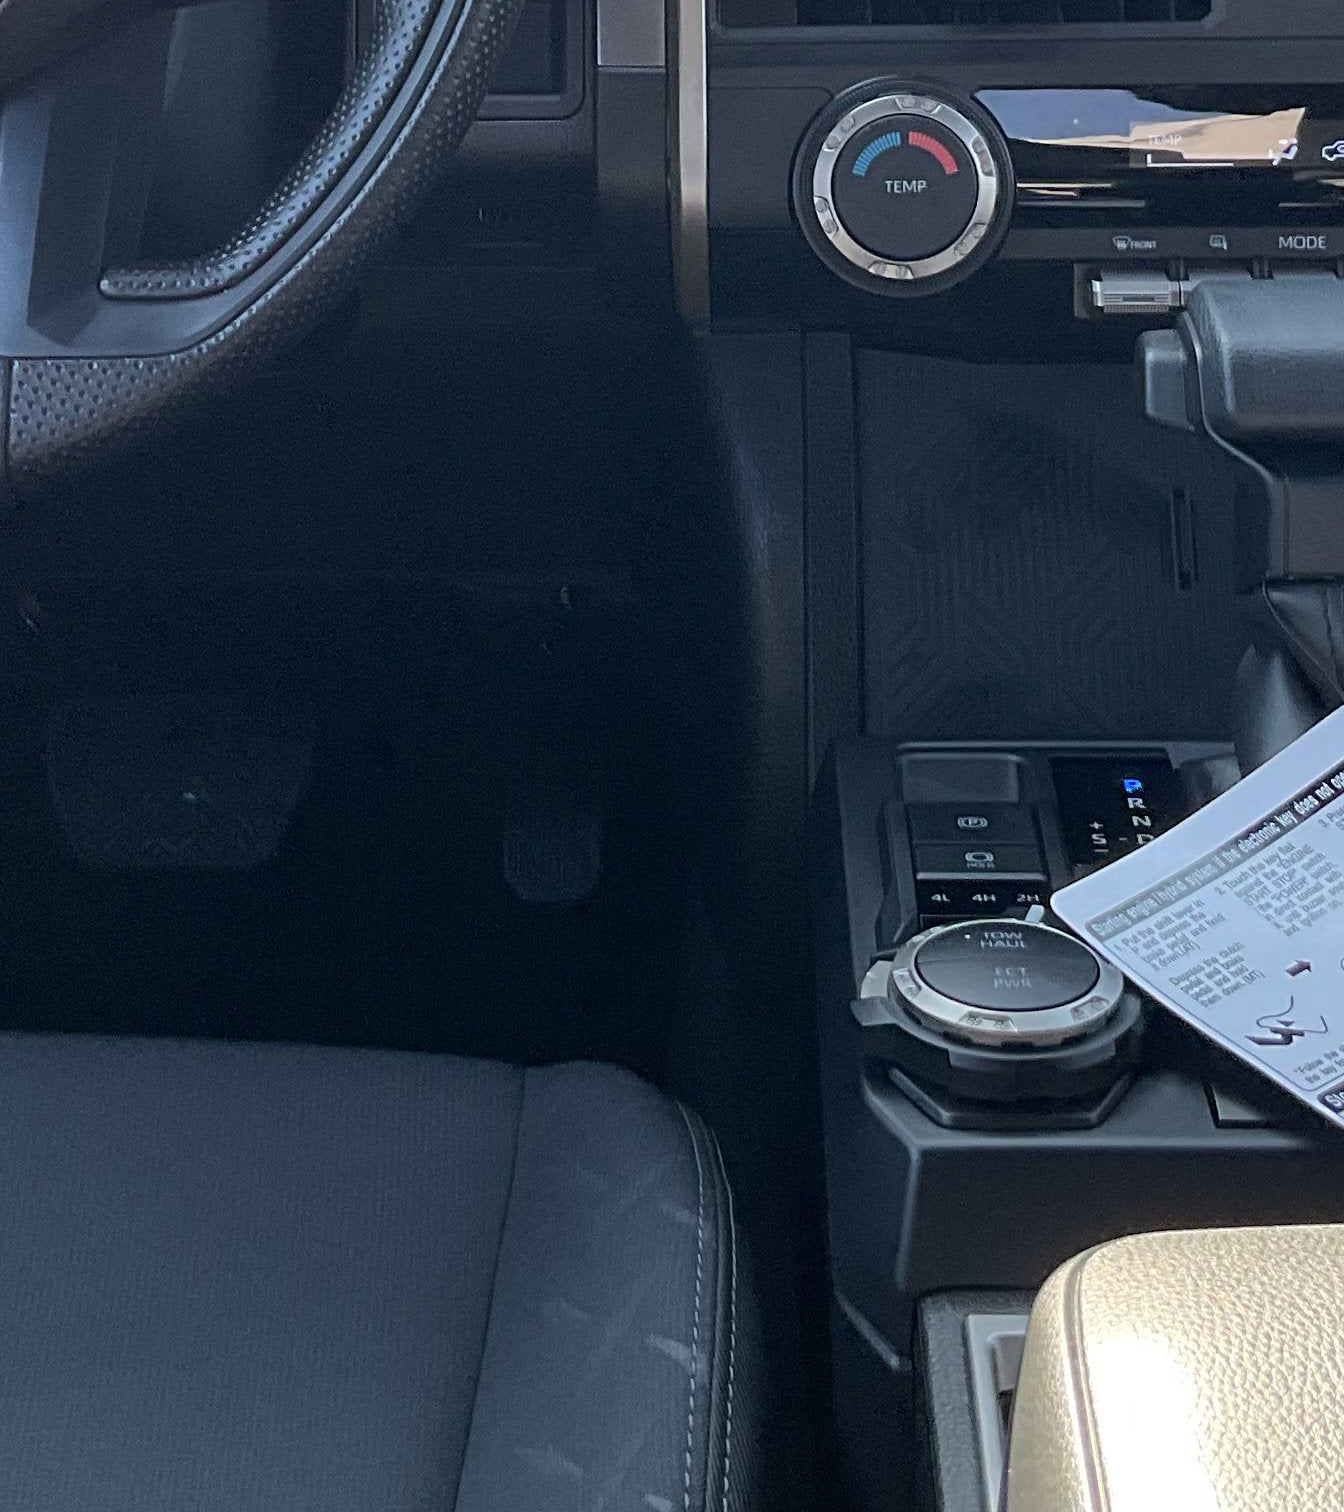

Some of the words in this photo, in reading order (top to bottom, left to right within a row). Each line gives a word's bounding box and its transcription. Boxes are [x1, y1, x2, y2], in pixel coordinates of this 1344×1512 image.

[884, 179, 928, 194] TEMP
[1278, 235, 1327, 251] MODE
[1127, 797, 1146, 809] R
[1132, 815, 1151, 828] N
[1091, 833, 1107, 845] S
[1090, 913, 1131, 936] Starting
[1221, 848, 1241, 862] the
[1238, 821, 1280, 852] electronic
[1273, 810, 1298, 826] key
[1293, 794, 1319, 814] does
[1314, 781, 1335, 799] not
[1222, 871, 1252, 889] Touch
[931, 894, 950, 903] 4L
[971, 893, 996, 903] 4H
[1016, 893, 1040, 903] 2H
[983, 931, 1023, 941] TOW
[980, 940, 1025, 949] HAUL
[993, 978, 1032, 989] PWR
